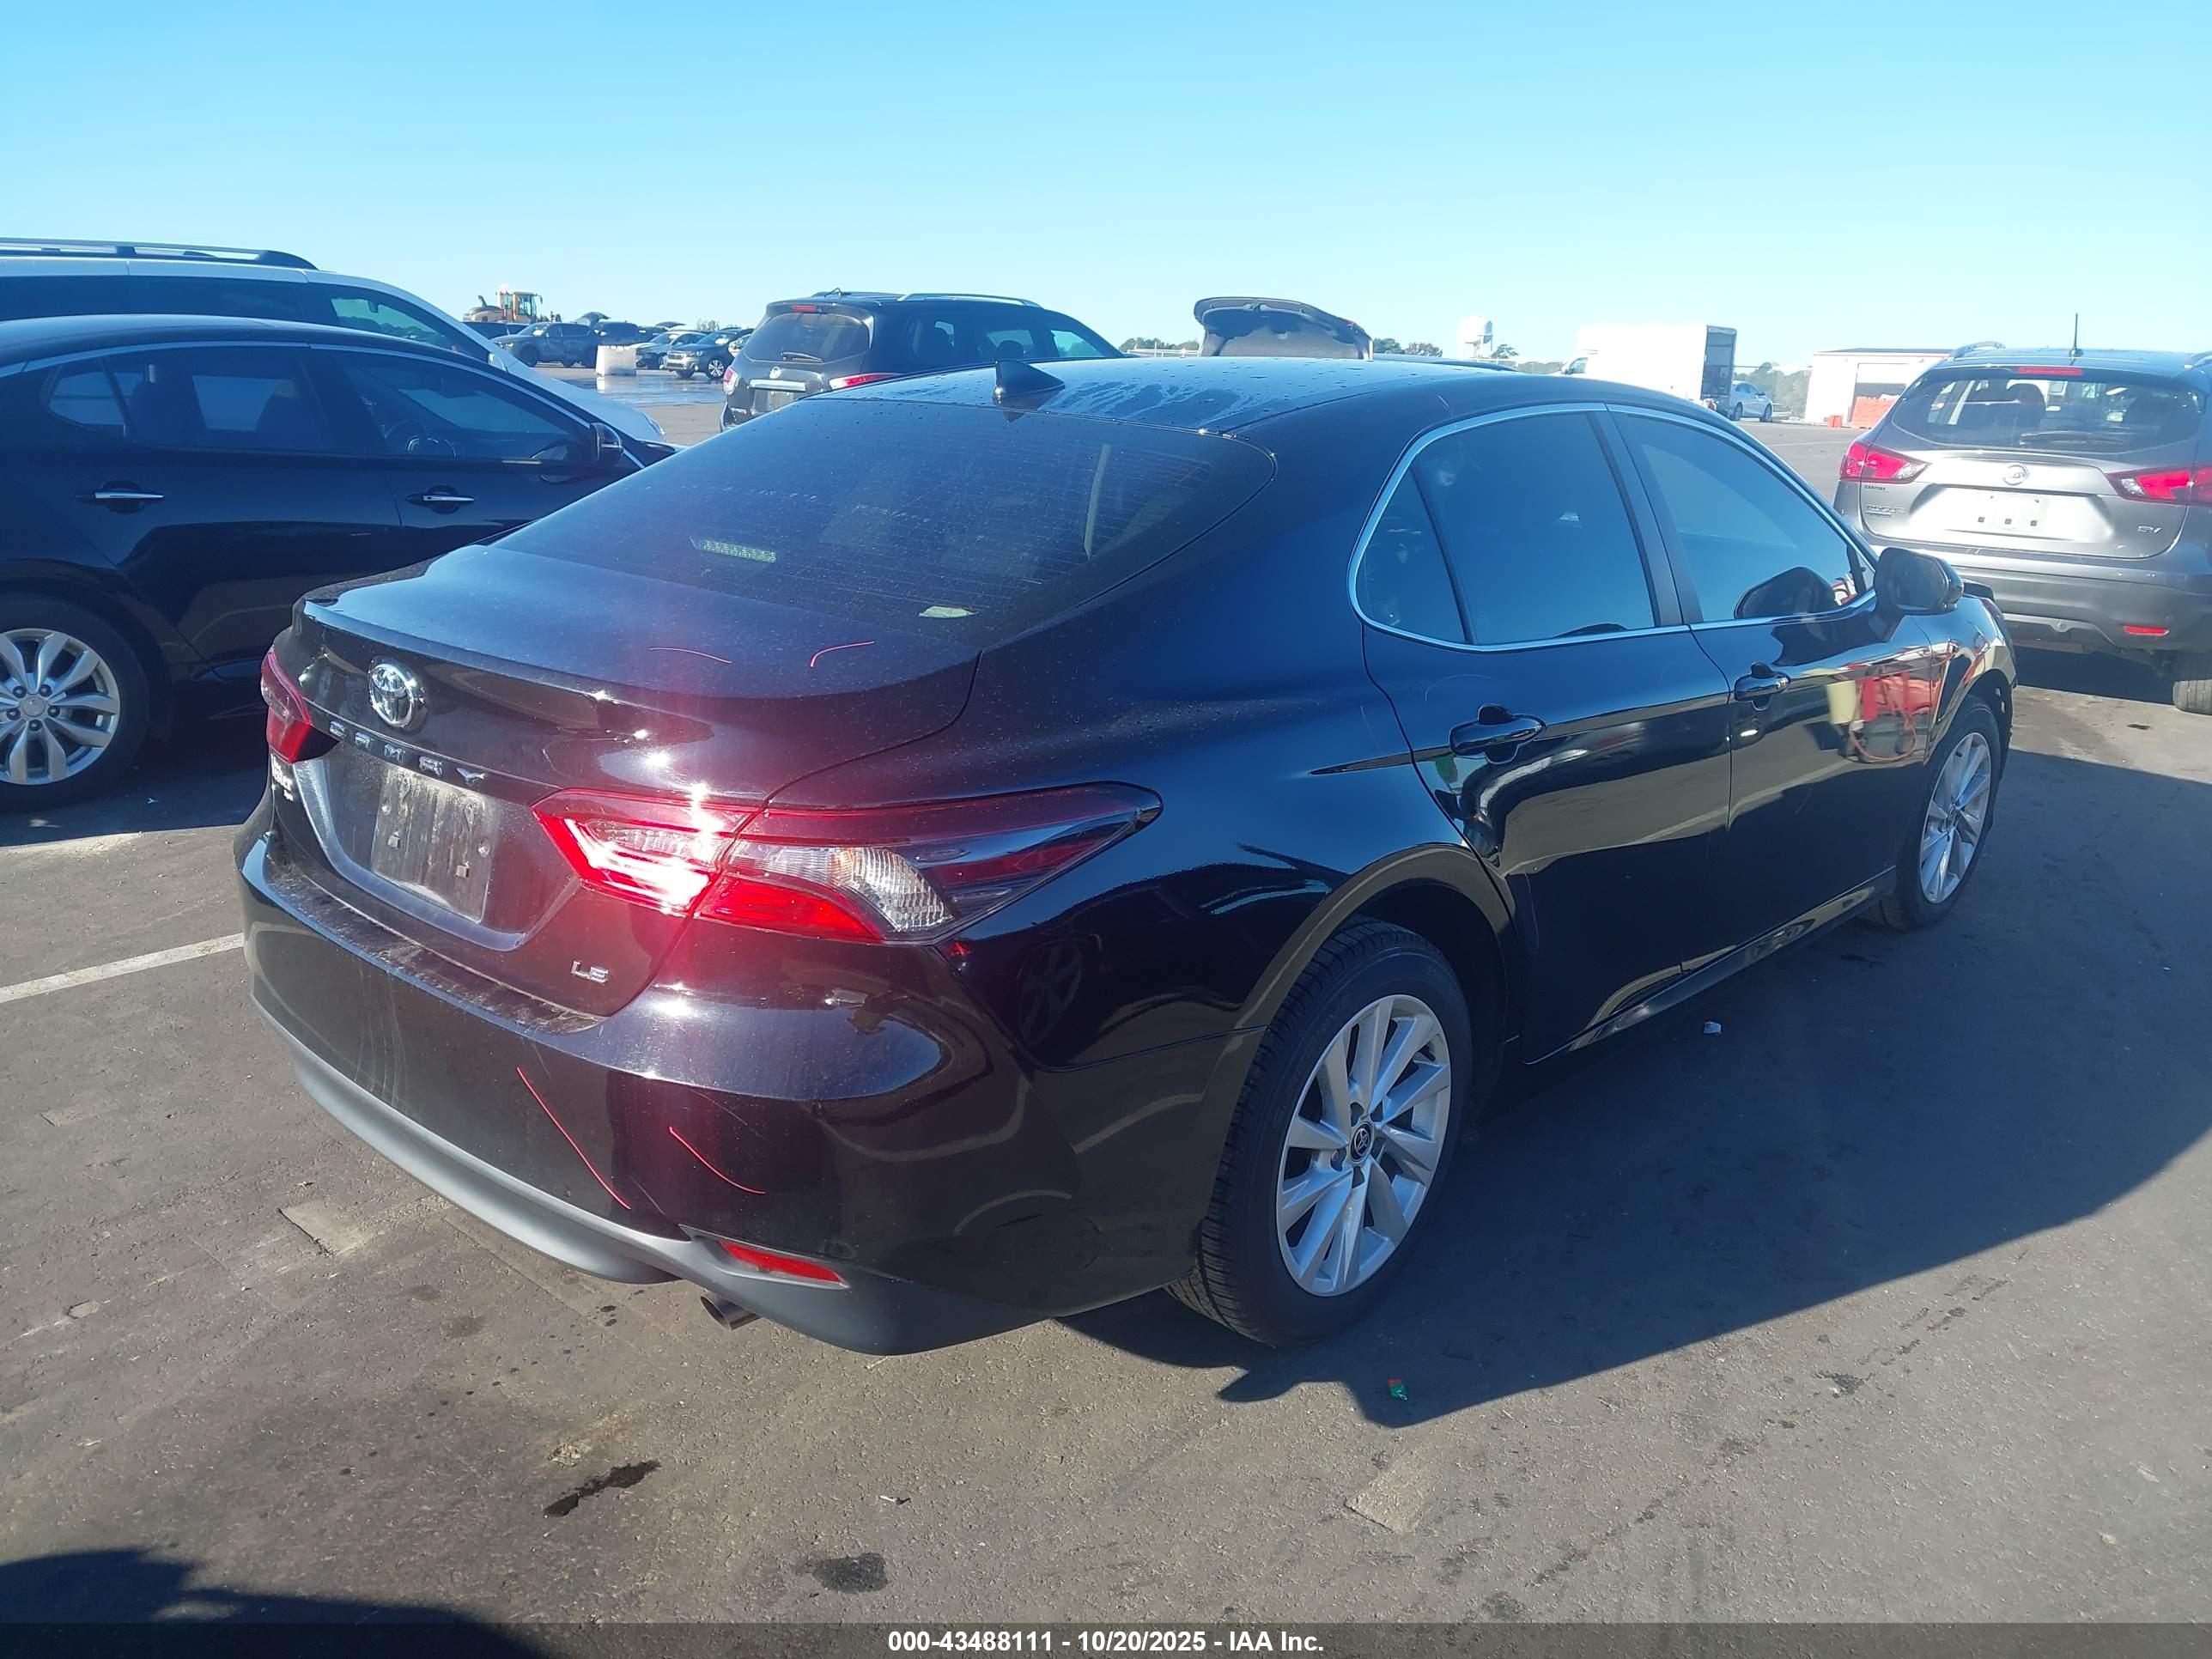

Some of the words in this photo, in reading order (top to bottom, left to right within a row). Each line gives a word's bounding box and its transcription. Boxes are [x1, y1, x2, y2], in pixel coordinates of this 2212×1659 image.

[2137, 525, 2162, 534] SV
[330, 720, 487, 786] CAMRY
[570, 960, 610, 985] LE
